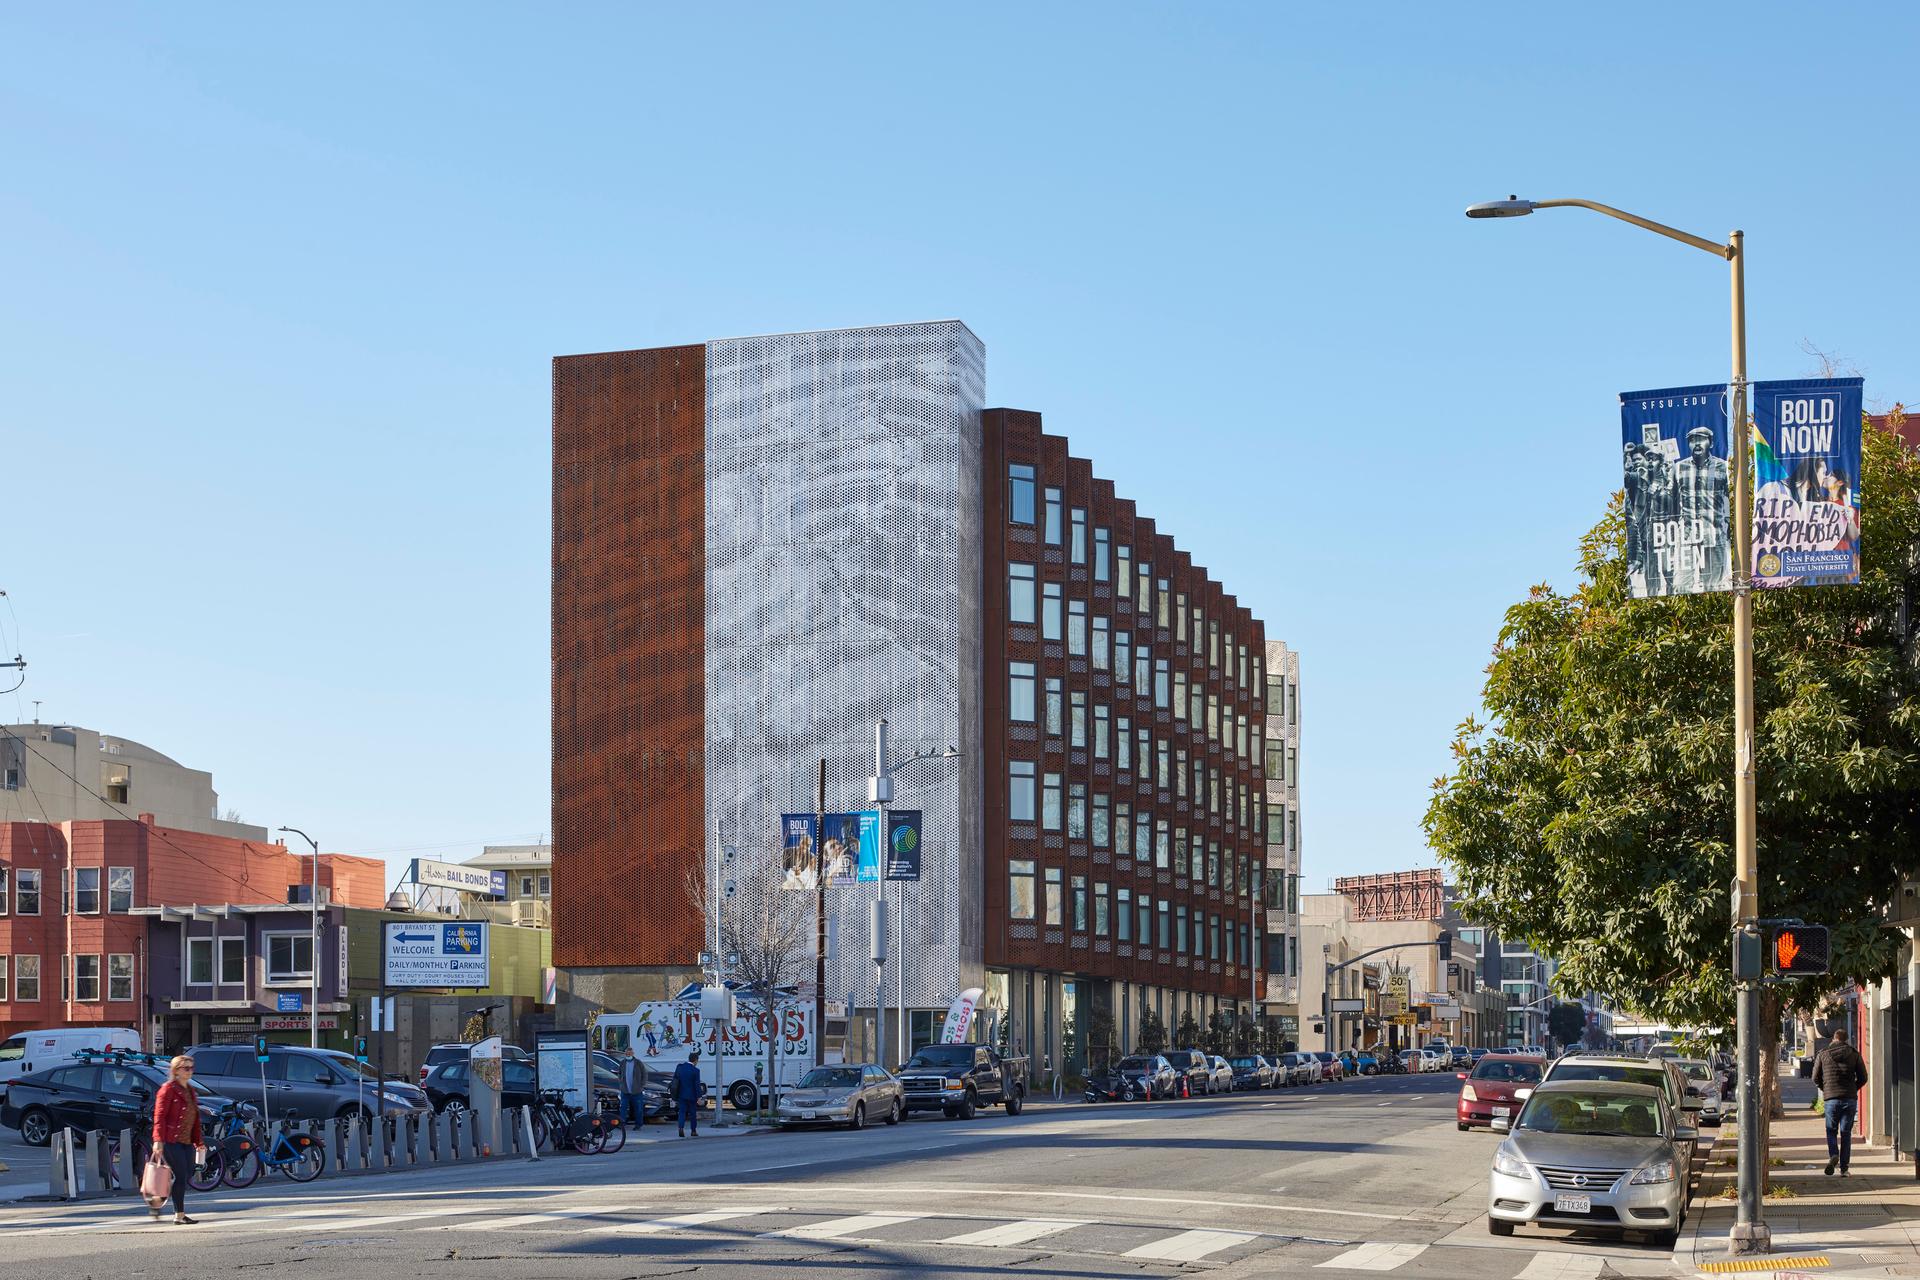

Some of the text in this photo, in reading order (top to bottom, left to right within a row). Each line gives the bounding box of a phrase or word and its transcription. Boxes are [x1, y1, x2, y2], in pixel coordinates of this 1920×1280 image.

[1642, 396, 1707, 410] SFSU.EDU
[1781, 398, 1834, 425] BOLD
[1781, 425, 1834, 454] NOW
[1809, 503, 1841, 524] END
[1652, 519, 1704, 547] BOLD
[1752, 520, 1841, 545] OMOPHOBIA
[1653, 545, 1706, 573] THEN
[1786, 554, 1850, 563] SAN FRANCISCO
[1807, 563, 1849, 571] UNIVERSITY
[790, 819, 808, 830] BOLD
[447, 870, 463, 882] BAIL
[464, 873, 489, 887] BONDS
[446, 937, 479, 946] PARKING
[392, 946, 435, 955] WELCOME
[389, 961, 448, 969] DAILY/MONTHLY
[1391, 977, 1403, 986] 50
[264, 1020, 309, 1029] SPORTS
